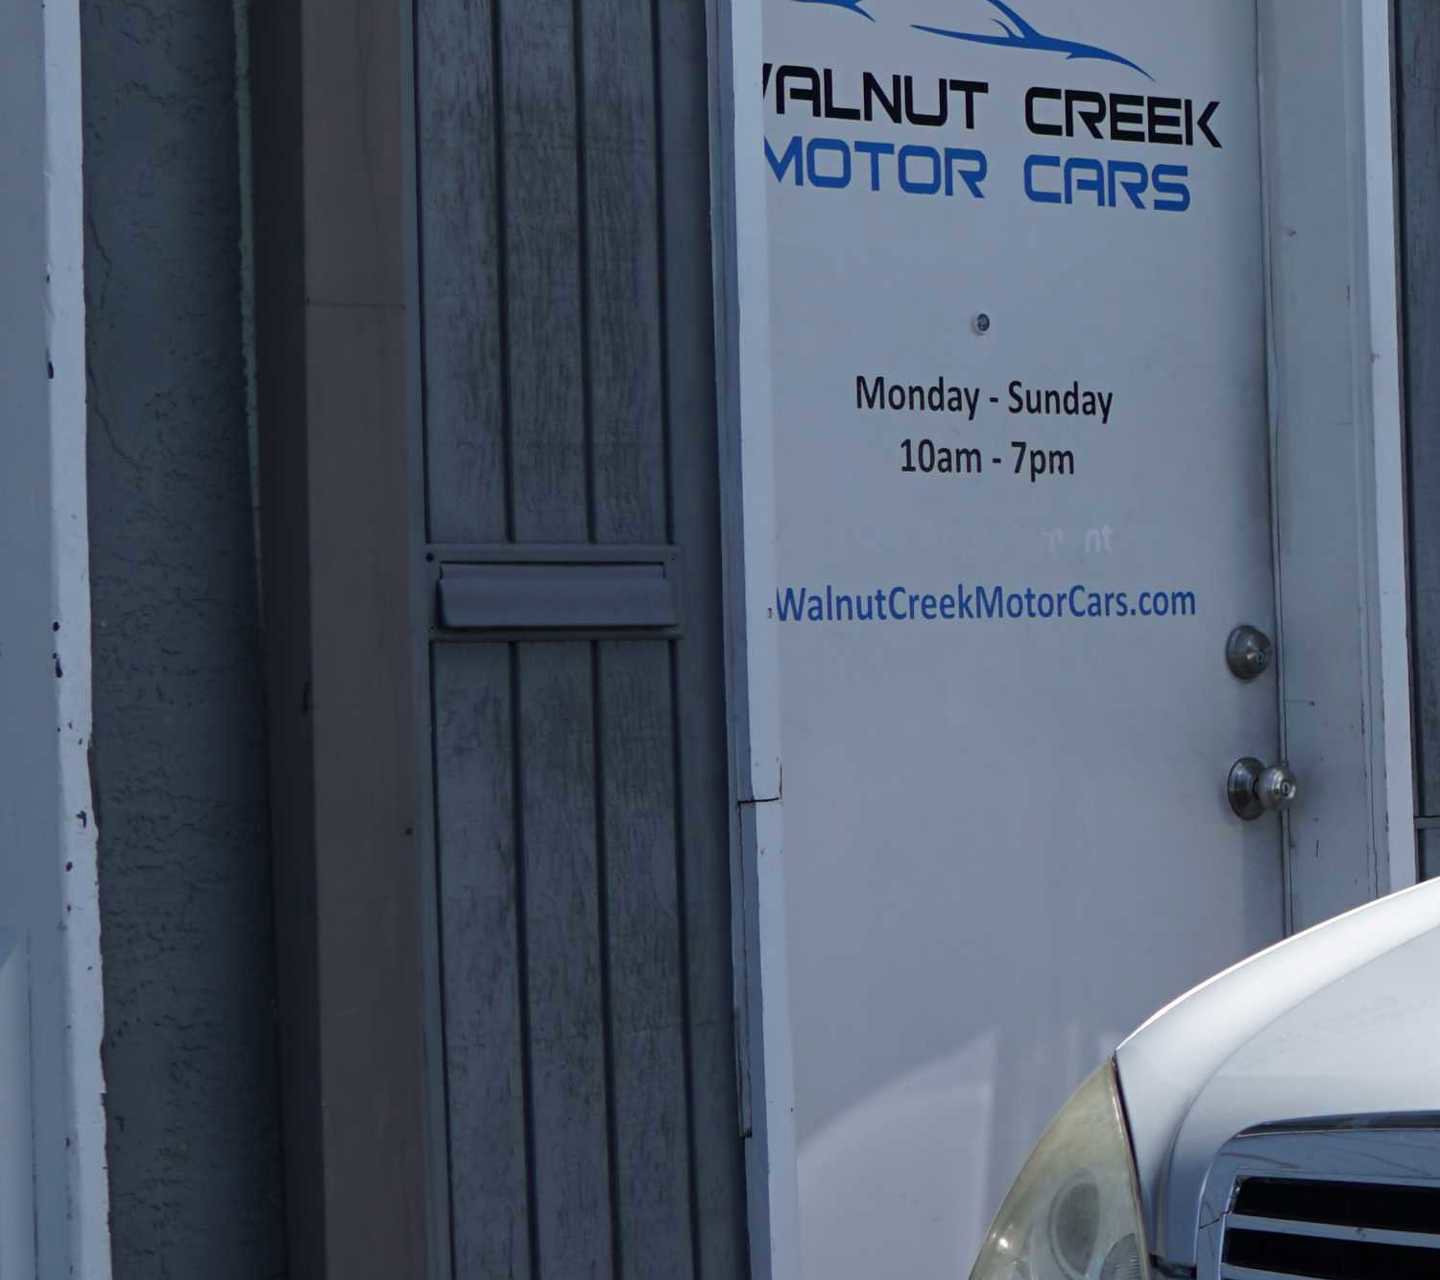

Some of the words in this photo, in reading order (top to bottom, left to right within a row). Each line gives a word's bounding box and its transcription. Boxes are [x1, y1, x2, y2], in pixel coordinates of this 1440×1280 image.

[1025, 86, 1223, 148] CREEK
[764, 135, 988, 198] MOTOR
[1023, 153, 1191, 212] CARS
[856, 375, 980, 420] Monday
[1008, 380, 1113, 424] Sunday
[900, 438, 982, 473] 10am
[1011, 441, 1074, 482] 7pm
[776, 584, 1196, 621] WalnutCreekMotorCars.com
